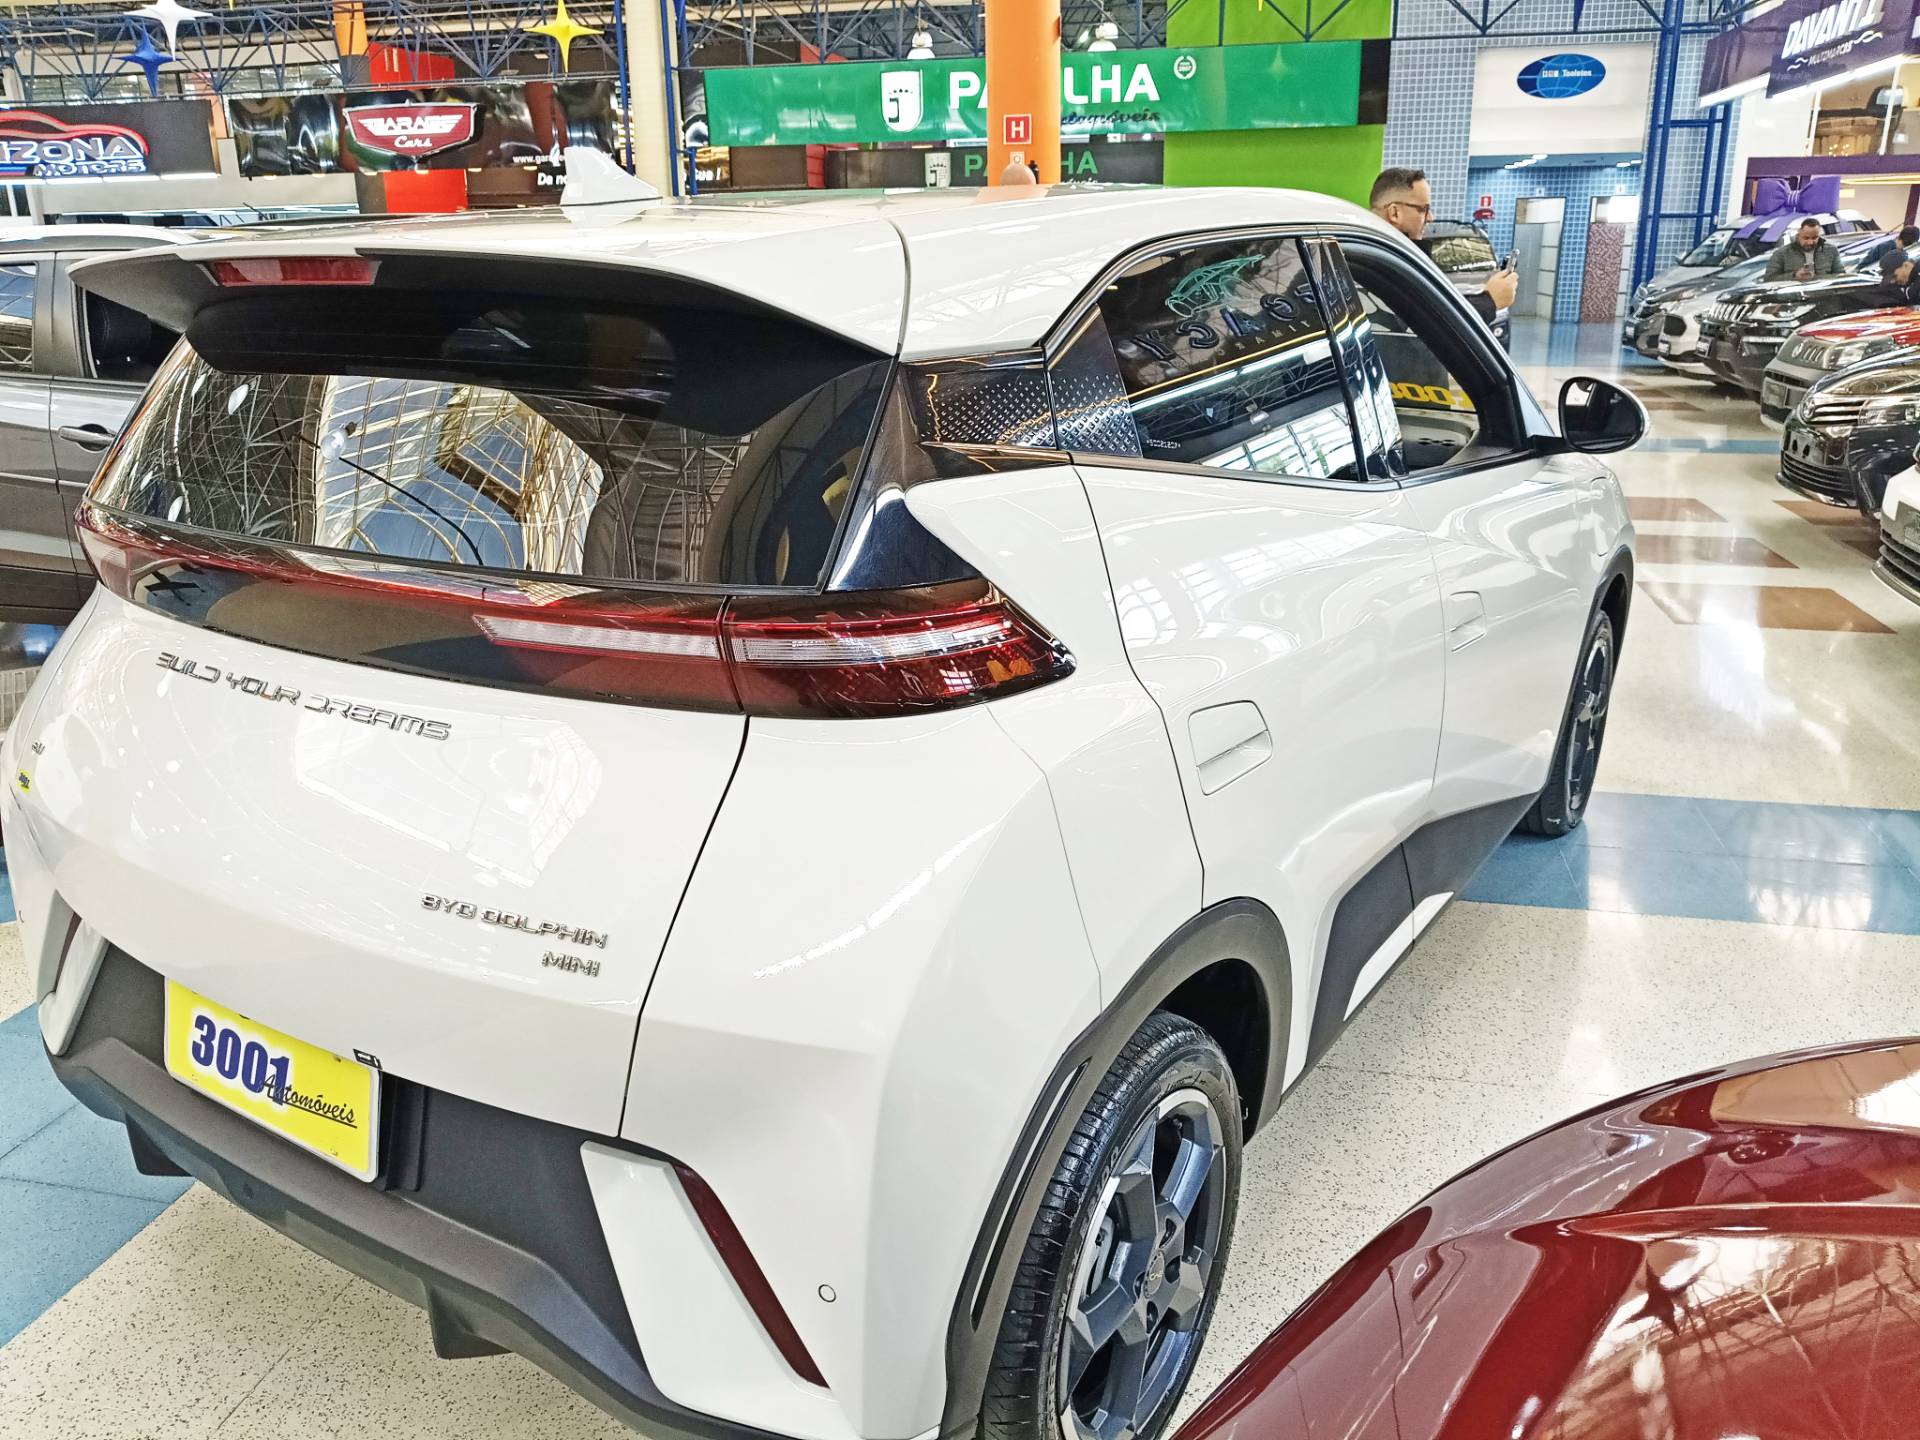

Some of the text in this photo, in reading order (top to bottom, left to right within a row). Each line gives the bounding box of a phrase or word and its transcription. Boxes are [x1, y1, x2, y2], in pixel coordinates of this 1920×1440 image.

[949, 64, 1161, 109] PLHA
[394, 136, 433, 148] Cars
[155, 651, 453, 742] BUILD YOUR DREAMS
[420, 892, 609, 950] BYD DOLPHIN
[541, 950, 601, 978] MINI
[192, 1014, 290, 1106] 3001
[262, 1073, 357, 1128] Automóveis
